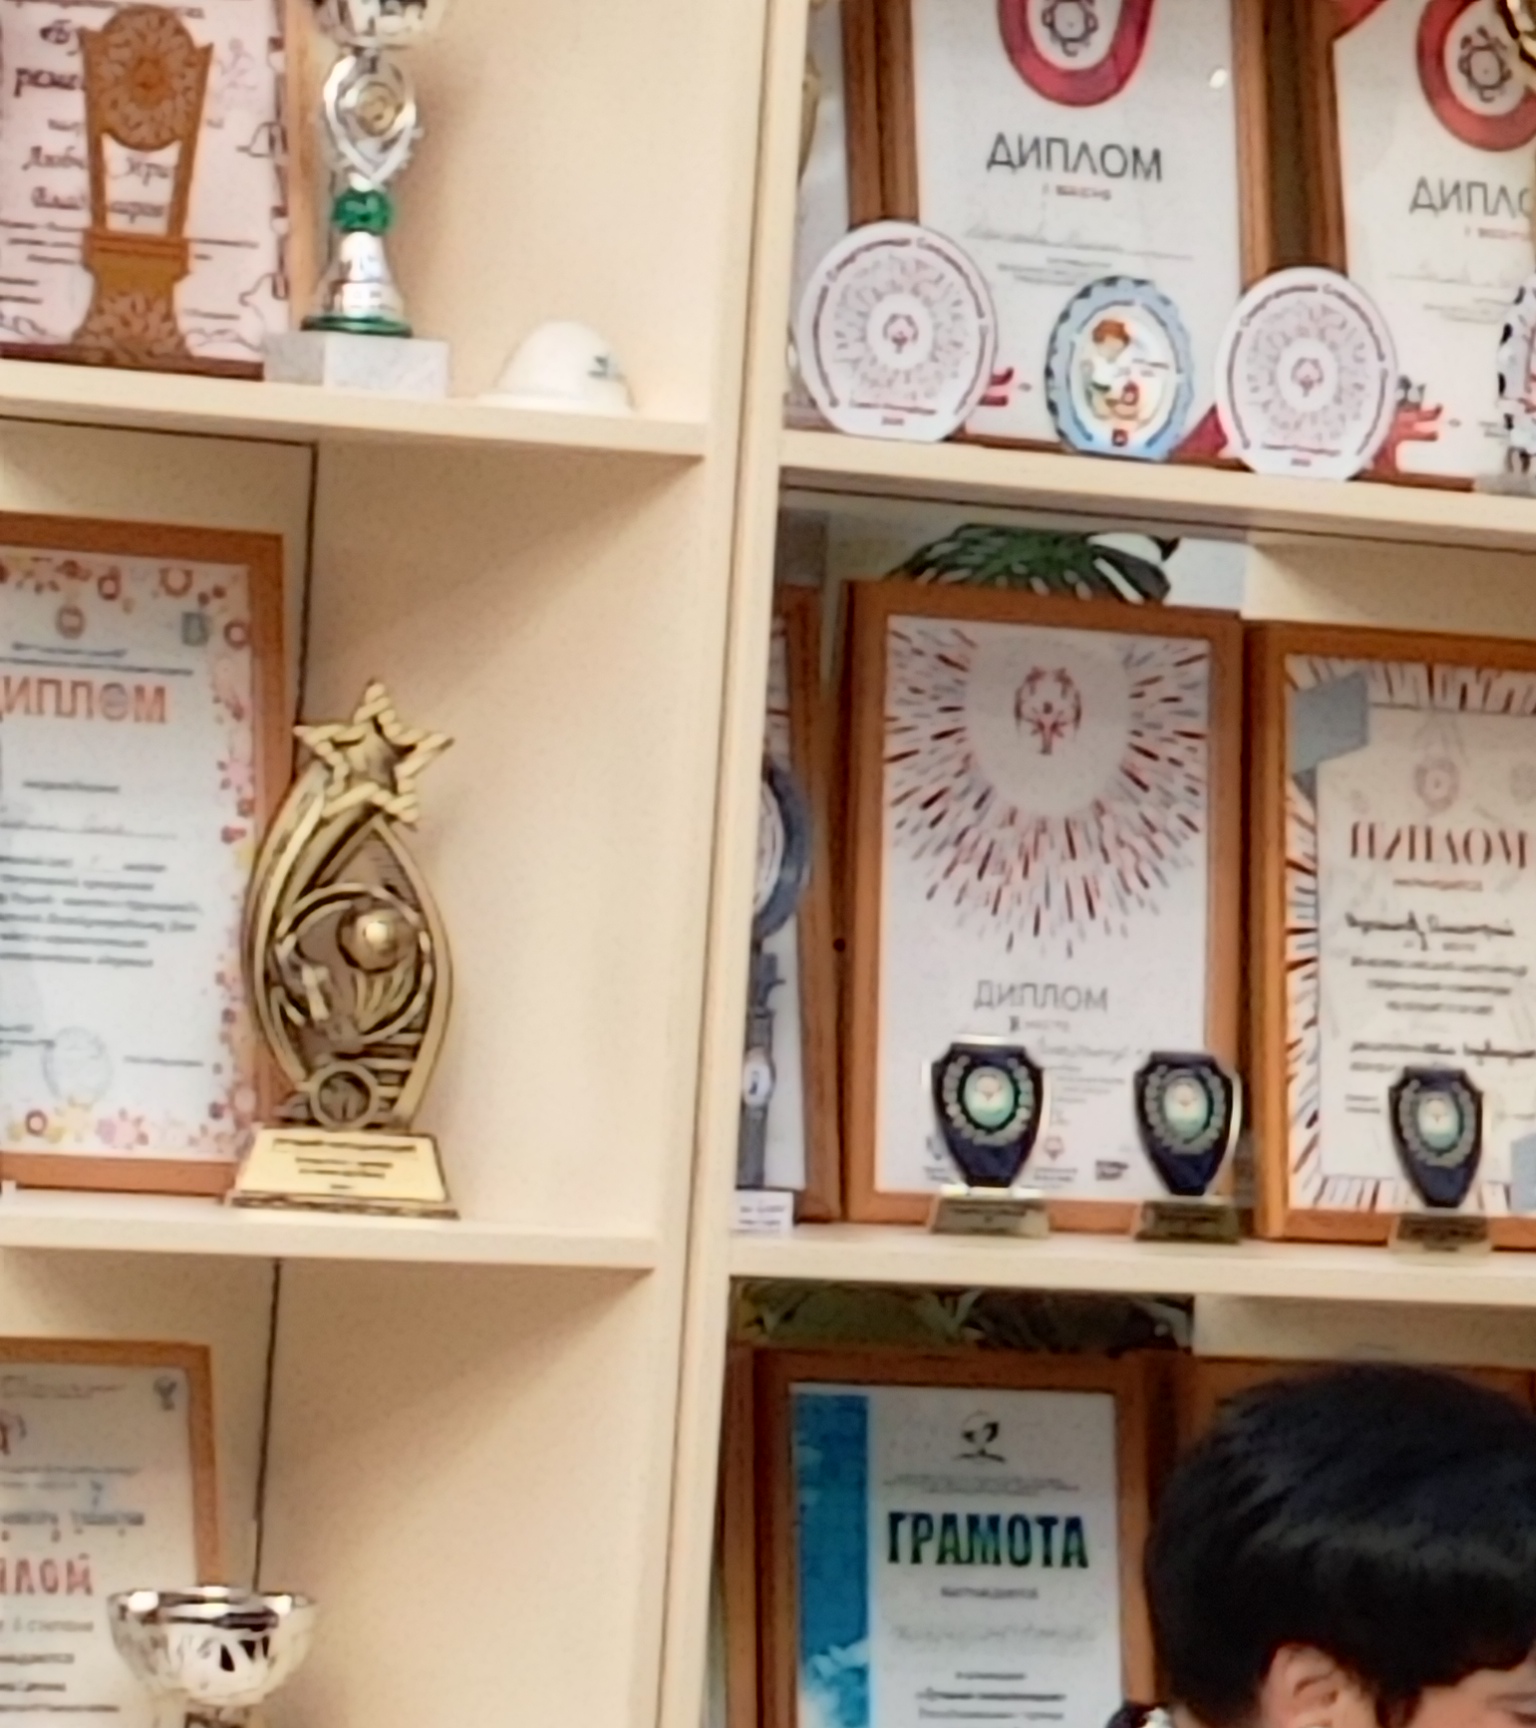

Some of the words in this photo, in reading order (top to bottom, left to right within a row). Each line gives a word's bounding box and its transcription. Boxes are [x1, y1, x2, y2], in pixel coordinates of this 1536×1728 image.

[985, 131, 1163, 183] ДИПЛОМ
[1408, 175, 1534, 220] ДИПЛО
[0, 674, 168, 725] ИПЛОМ
[1349, 820, 1528, 871] ДИПЛОМ
[973, 979, 1109, 1013] ДИПЛОМ
[887, 1511, 1090, 1569] ГРАМОТА
